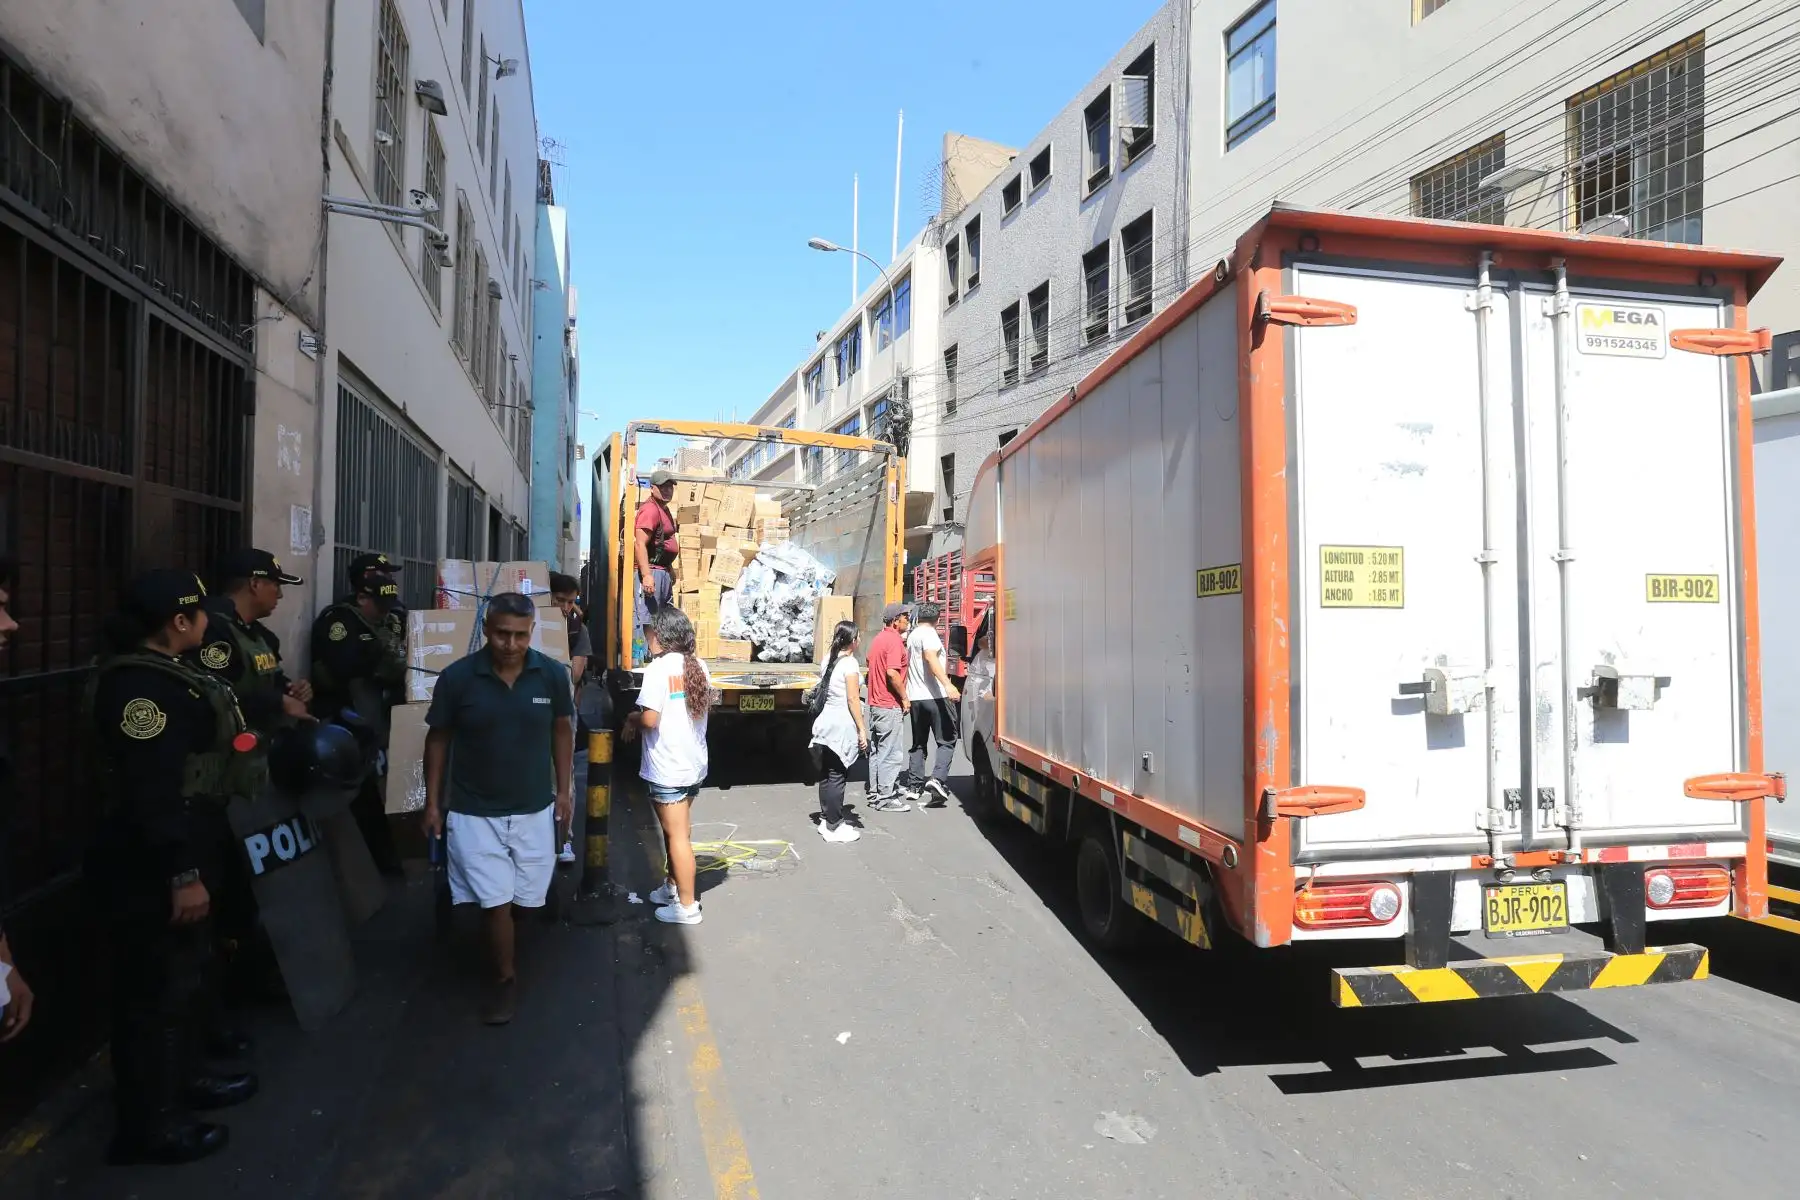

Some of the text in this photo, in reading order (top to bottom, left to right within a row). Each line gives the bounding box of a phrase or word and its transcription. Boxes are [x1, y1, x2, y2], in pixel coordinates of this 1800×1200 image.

[1583, 308, 1658, 328] MEGA
[1586, 337, 1657, 351] 991524345
[1324, 551, 1364, 565] LONGITUD
[1388, 553, 1399, 566] MT
[1324, 570, 1354, 583] ALTURA
[1388, 571, 1400, 584] MT
[1325, 588, 1353, 602] ANCHO
[1389, 589, 1400, 602] MT
[1651, 578, 1714, 598] BJR-902
[179, 594, 199, 605] PERU
[1511, 887, 1540, 896] PERU
[1489, 894, 1562, 926] BJR-902
